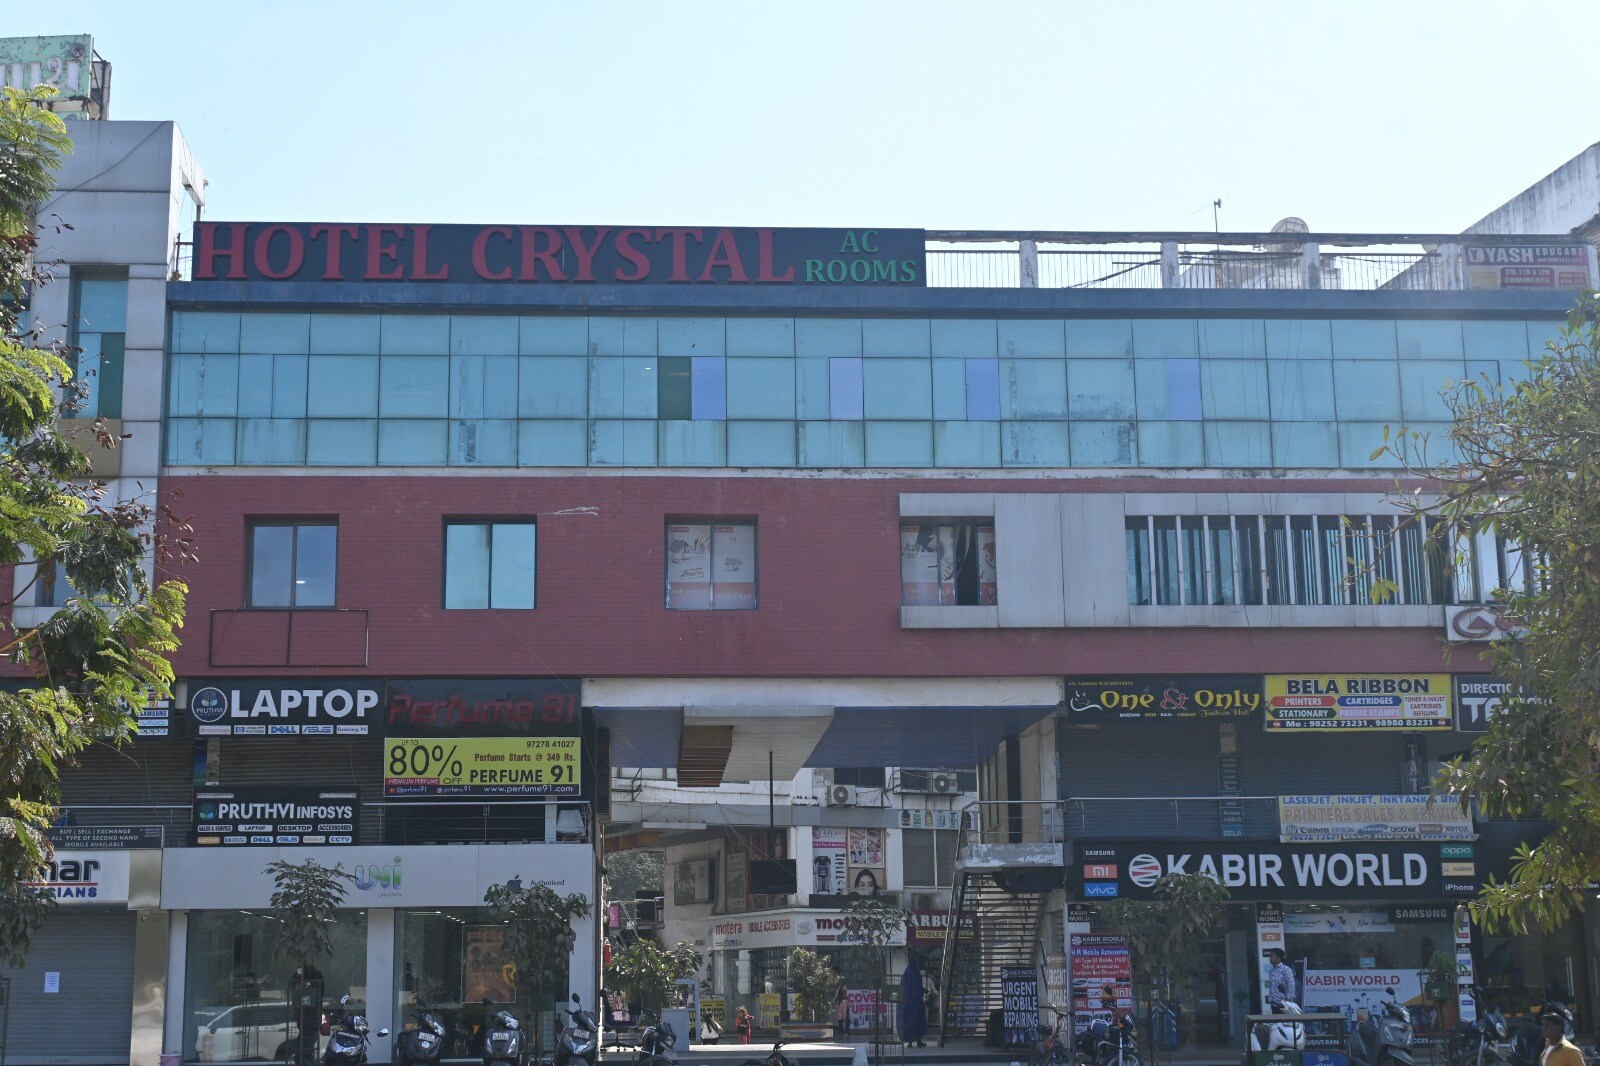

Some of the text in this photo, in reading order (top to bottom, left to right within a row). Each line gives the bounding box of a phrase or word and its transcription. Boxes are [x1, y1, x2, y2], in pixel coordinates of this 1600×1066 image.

[839, 230, 879, 253] AC
[194, 223, 795, 284] HOTEL CRYSTAL
[1486, 247, 1584, 263] YASH EDUCARE
[804, 259, 917, 283] ROOMS
[1287, 677, 1430, 695] BELA RIBBON
[230, 688, 379, 718] LAPTOP
[1100, 688, 1260, 712] One & Only
[1284, 697, 1322, 706] PRINTERS
[1345, 697, 1394, 706] CARTRIDGES
[388, 693, 577, 724] Perfume 91
[1201, 708, 1250, 718] Fashion Hub
[1279, 709, 1329, 718] STATIONARY
[1339, 708, 1400, 717] PREINK STAMPS
[270, 725, 297, 734] DELL
[303, 726, 332, 734] ASUS
[526, 740, 575, 748] 97278 41027
[389, 744, 463, 777] 80%
[474, 753, 505, 763] Perfume
[508, 753, 531, 762] Starts
[546, 753, 560, 762] 349
[564, 752, 576, 762] Rs.
[469, 764, 574, 783] PERFUME 91
[442, 777, 463, 785] OFF
[484, 784, 573, 794] www.perfume91.com
[1282, 796, 1335, 806] LASERJET,
[1337, 795, 1377, 805] INKJET,
[1379, 795, 1427, 804] INKTANK
[218, 802, 353, 819] PRUTHVI INFOSYS
[1282, 807, 1350, 822] PRINTERS
[1353, 807, 1395, 822] SALES
[1400, 806, 1408, 821] &
[1300, 826, 1330, 834] Canon
[1167, 852, 1428, 887] KABIR WORLD
[530, 879, 565, 887] Authorised
[1445, 883, 1474, 891] iPhone
[1086, 885, 1116, 895] vivo
[1395, 908, 1447, 918] SAMSUNG
[715, 921, 743, 935] motera
[1305, 975, 1400, 986] KABIR WORLD
[1002, 981, 1037, 995] URGENT
[1003, 996, 1038, 1010] MOBILE
[1003, 1011, 1039, 1028] REPAIRING
